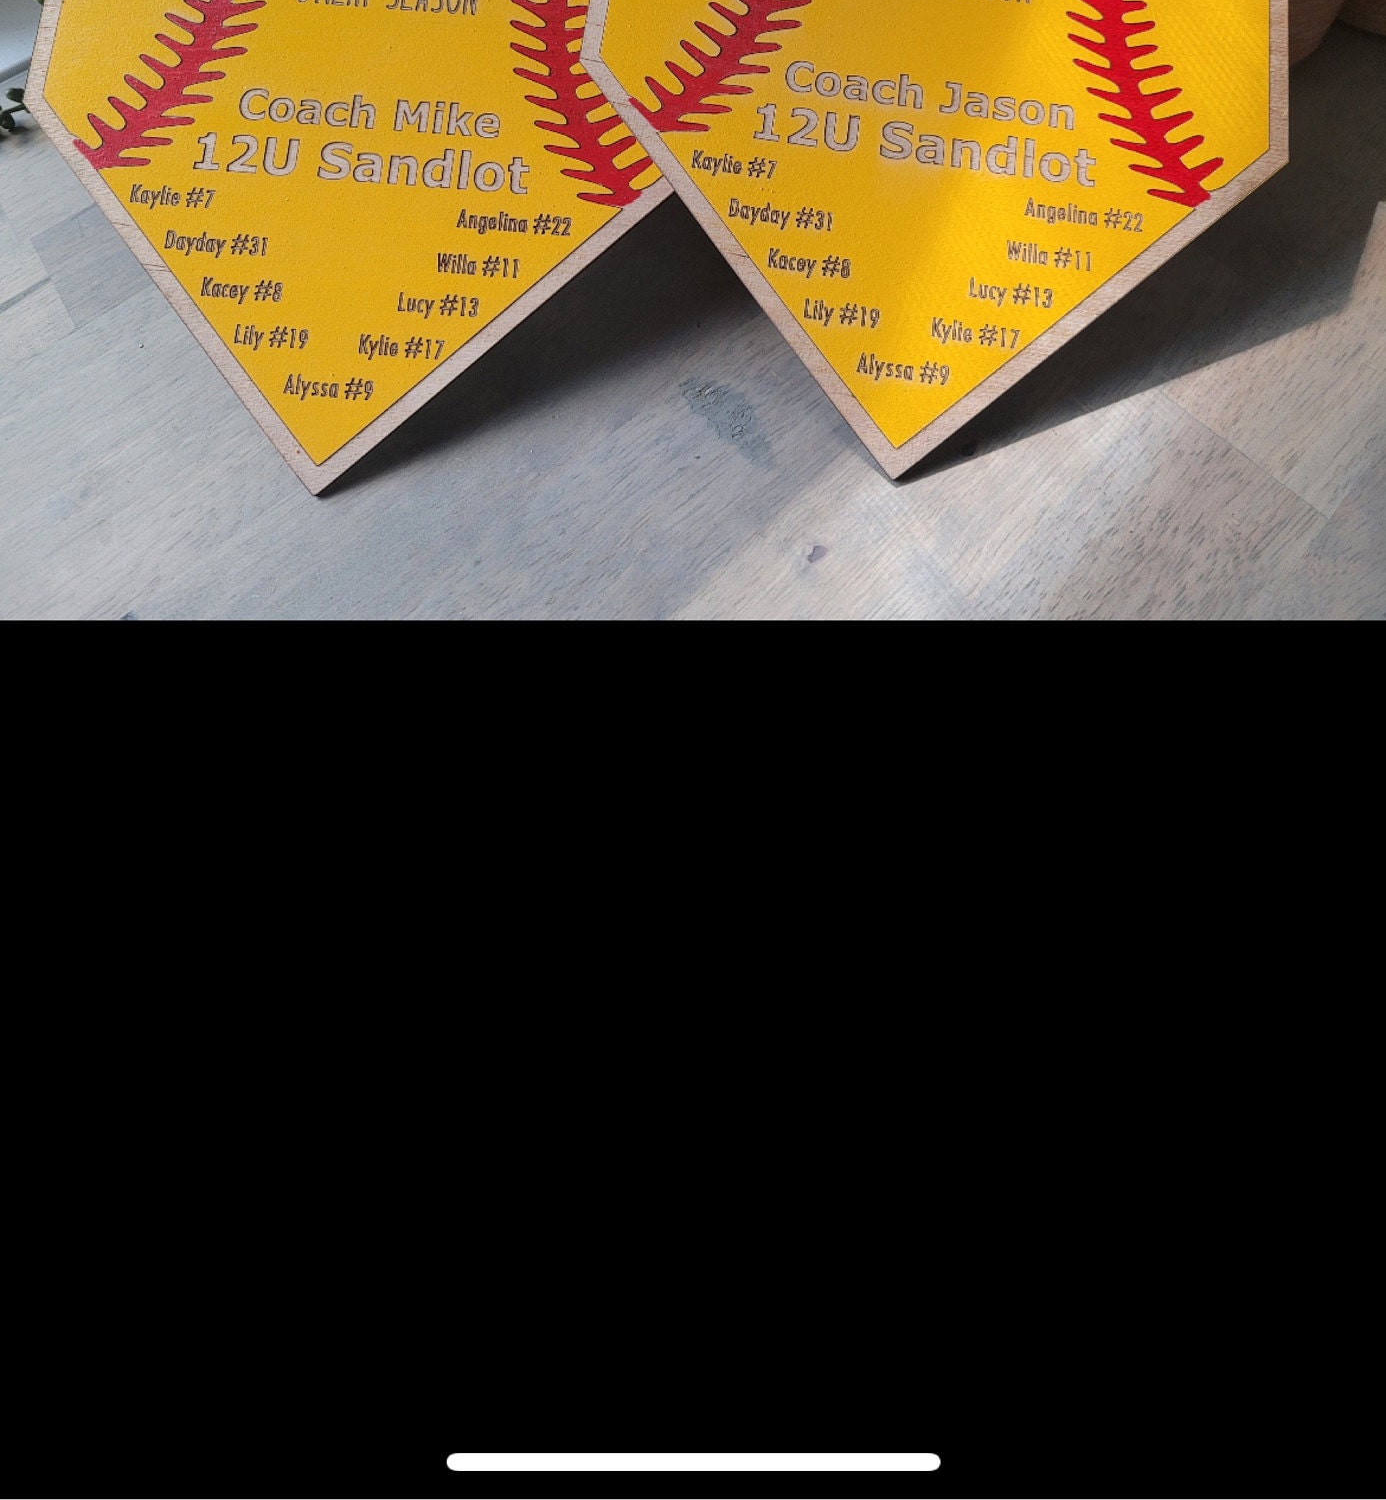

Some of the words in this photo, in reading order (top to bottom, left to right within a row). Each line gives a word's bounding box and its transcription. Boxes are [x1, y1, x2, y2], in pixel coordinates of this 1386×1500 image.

[785, 60, 923, 109] Coach
[939, 81, 1075, 130] Jason
[239, 88, 376, 129] Coach
[394, 99, 500, 138] Mike
[753, 103, 860, 151] 12U
[880, 121, 1096, 187] Sandlot
[193, 132, 300, 176] 12U
[317, 141, 530, 194] Sandlot
[691, 150, 742, 176] Kaylie
[748, 157, 777, 179] #7
[130, 184, 180, 209] Kaylie
[186, 187, 216, 208] #7
[457, 209, 528, 234] Angelina
[533, 214, 572, 236] #22
[729, 198, 790, 230] Dayday
[796, 207, 833, 231] #31
[1024, 197, 1098, 226] Angelina
[1104, 208, 1144, 232] #22
[164, 230, 226, 258] Dayday
[231, 234, 268, 256] #31
[1007, 240, 1048, 266] Willa
[1054, 247, 1092, 271] #11
[437, 253, 476, 275] Willa
[482, 256, 519, 278] #11
[768, 248, 817, 278] Kacey
[822, 255, 851, 278] #8
[201, 277, 249, 304] Kacey
[254, 280, 283, 302] #8
[398, 292, 435, 319] Lucy
[440, 294, 479, 317] #13
[969, 277, 1007, 307] Lucy
[1013, 283, 1053, 309] #13
[803, 299, 834, 326] Lily
[839, 303, 880, 329] #19
[234, 324, 264, 350] Lily
[269, 326, 309, 349] #19
[359, 334, 398, 360] Kylie
[405, 337, 445, 359] #17
[931, 317, 972, 344] Kylie
[978, 324, 1021, 349] #17
[856, 353, 914, 380] Alyssa
[919, 361, 950, 385] #9
[283, 374, 339, 400] Alyssa
[344, 378, 374, 400] #9
